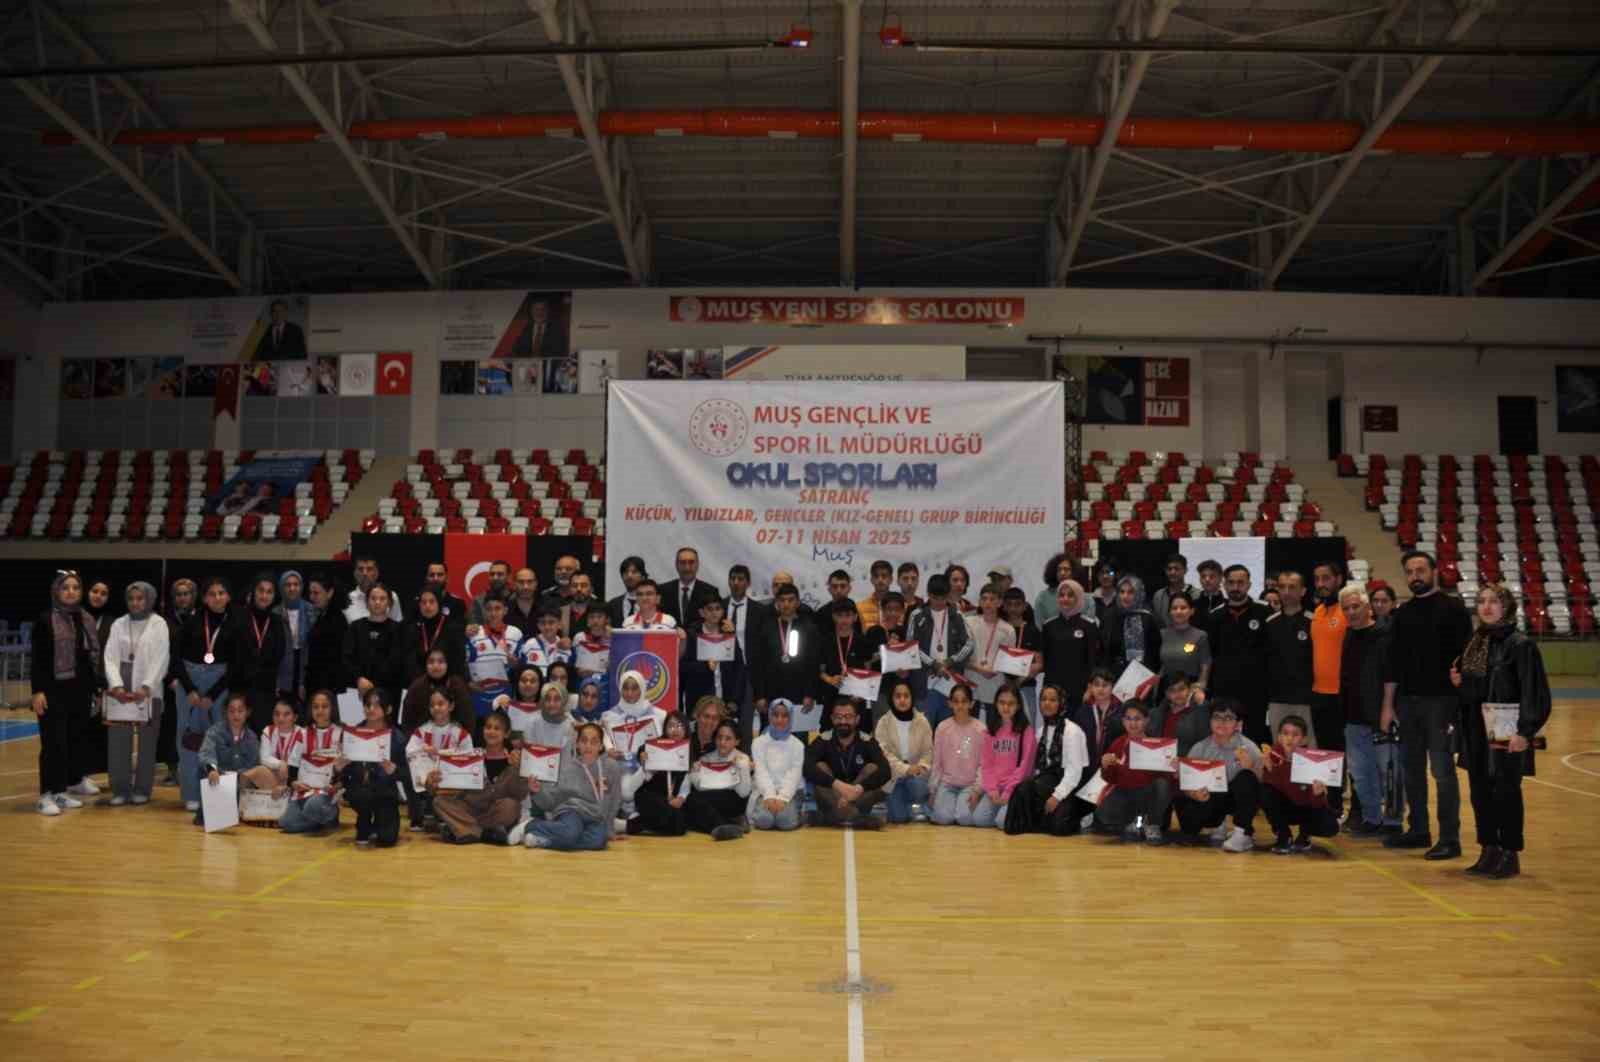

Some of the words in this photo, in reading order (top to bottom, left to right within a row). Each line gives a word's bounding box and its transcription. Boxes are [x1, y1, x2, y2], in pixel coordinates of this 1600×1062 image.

[706, 302, 763, 323] MUŞ
[769, 298, 827, 319] YENİ
[832, 302, 902, 320] SPOR
[907, 302, 1013, 320] SALONU
[753, 405, 802, 428] MUŞ
[807, 402, 900, 428] GENÇLİK
[905, 406, 932, 424] VE
[753, 435, 811, 454] SPOR
[816, 432, 835, 454] İL
[840, 432, 983, 455] MÜDÜRLÜĞÜ
[726, 462, 801, 488] OKUL
[804, 462, 938, 489] SPORLARI
[798, 488, 872, 506] SATRANÇ
[623, 503, 677, 524] KÜÇÜK,
[683, 507, 759, 524] YILDIZLAR,
[919, 509, 961, 524] GRUP
[755, 528, 804, 545] 07-11
[867, 528, 913, 545] 2025
[812, 544, 856, 566] Muş
